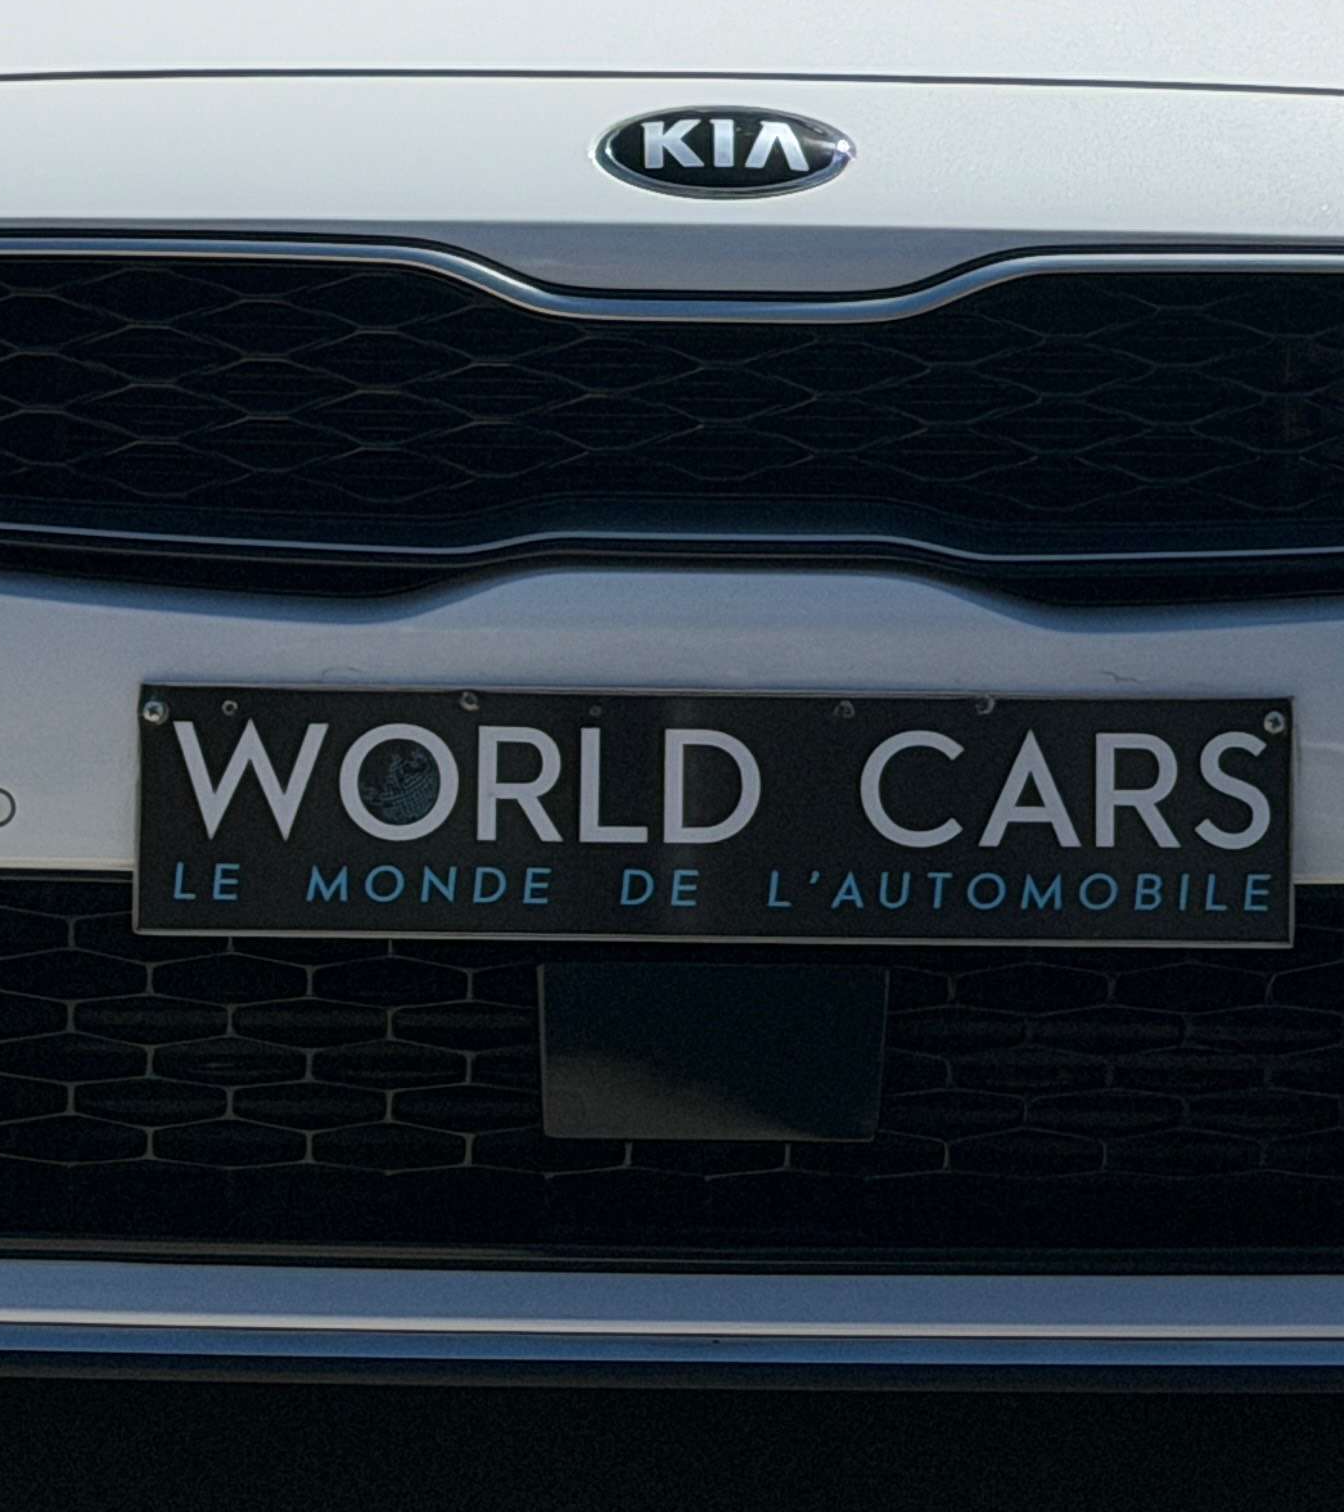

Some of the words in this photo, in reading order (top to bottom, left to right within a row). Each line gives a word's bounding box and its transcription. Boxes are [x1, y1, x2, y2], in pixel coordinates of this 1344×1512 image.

[641, 118, 811, 172] KIA
[173, 719, 761, 844] WORLD
[860, 728, 1271, 850] CARS
[173, 862, 241, 901] LE
[306, 865, 552, 904] MONDE
[620, 869, 700, 907] DE
[767, 871, 1272, 912] L'AUTOMOBILE
